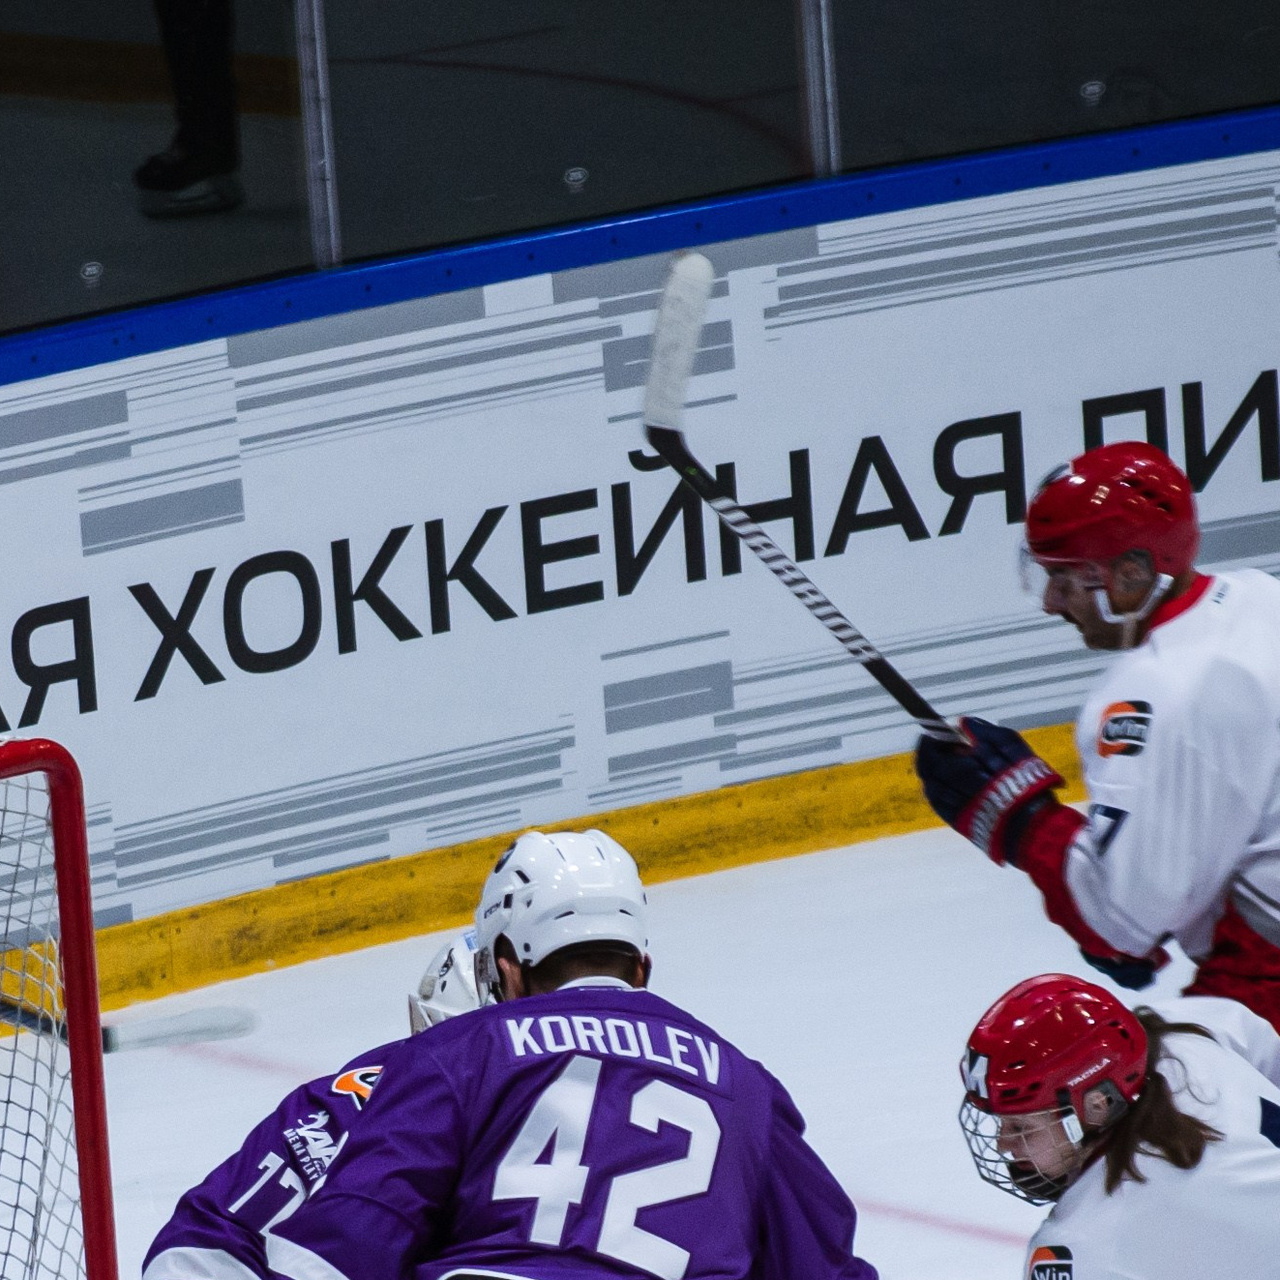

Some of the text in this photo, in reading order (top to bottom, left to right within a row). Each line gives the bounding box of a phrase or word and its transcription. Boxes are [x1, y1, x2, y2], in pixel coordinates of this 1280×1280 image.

[126, 411, 1027, 702] ХОККЕЙНАЯ
[506, 1015, 719, 1085] KOROLEV
[299, 1155, 321, 1181] PLAY
